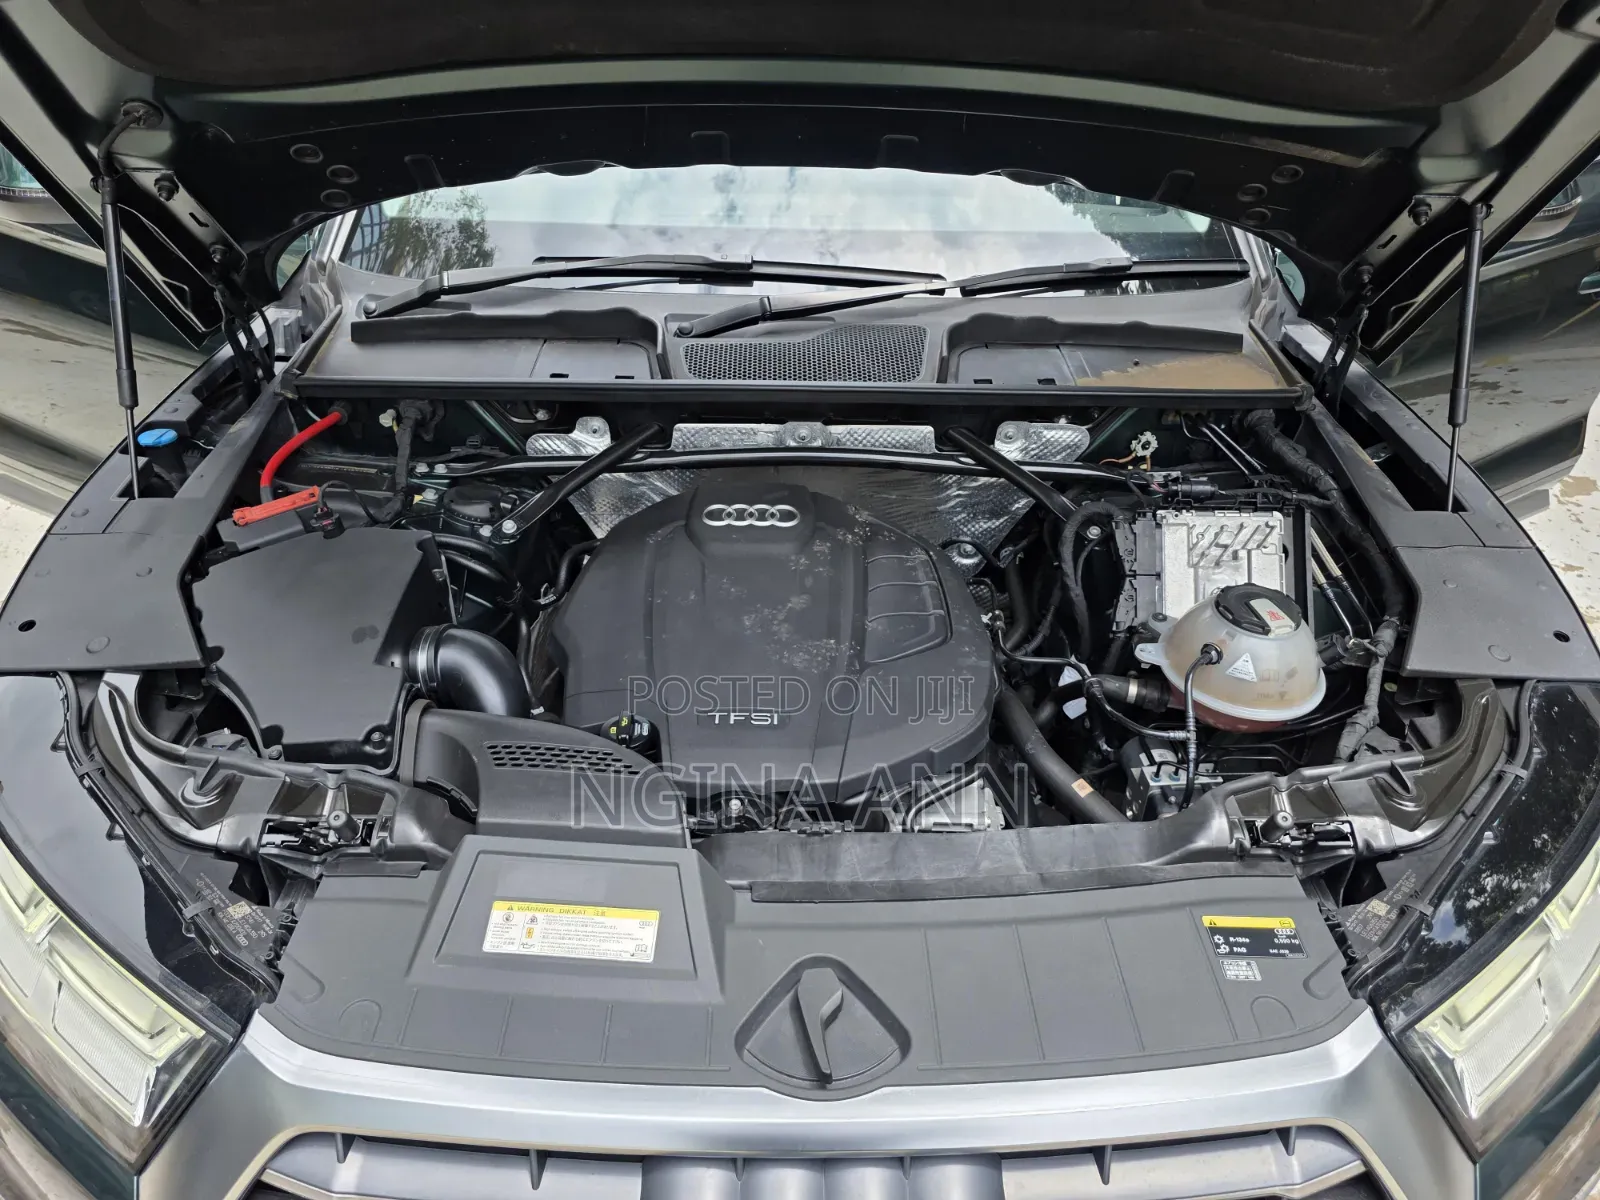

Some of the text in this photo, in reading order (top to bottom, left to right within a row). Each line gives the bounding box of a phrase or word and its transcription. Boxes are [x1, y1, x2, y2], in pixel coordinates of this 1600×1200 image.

[707, 712, 778, 725] TFSI
[517, 905, 587, 916] WARNING DIKKAT
